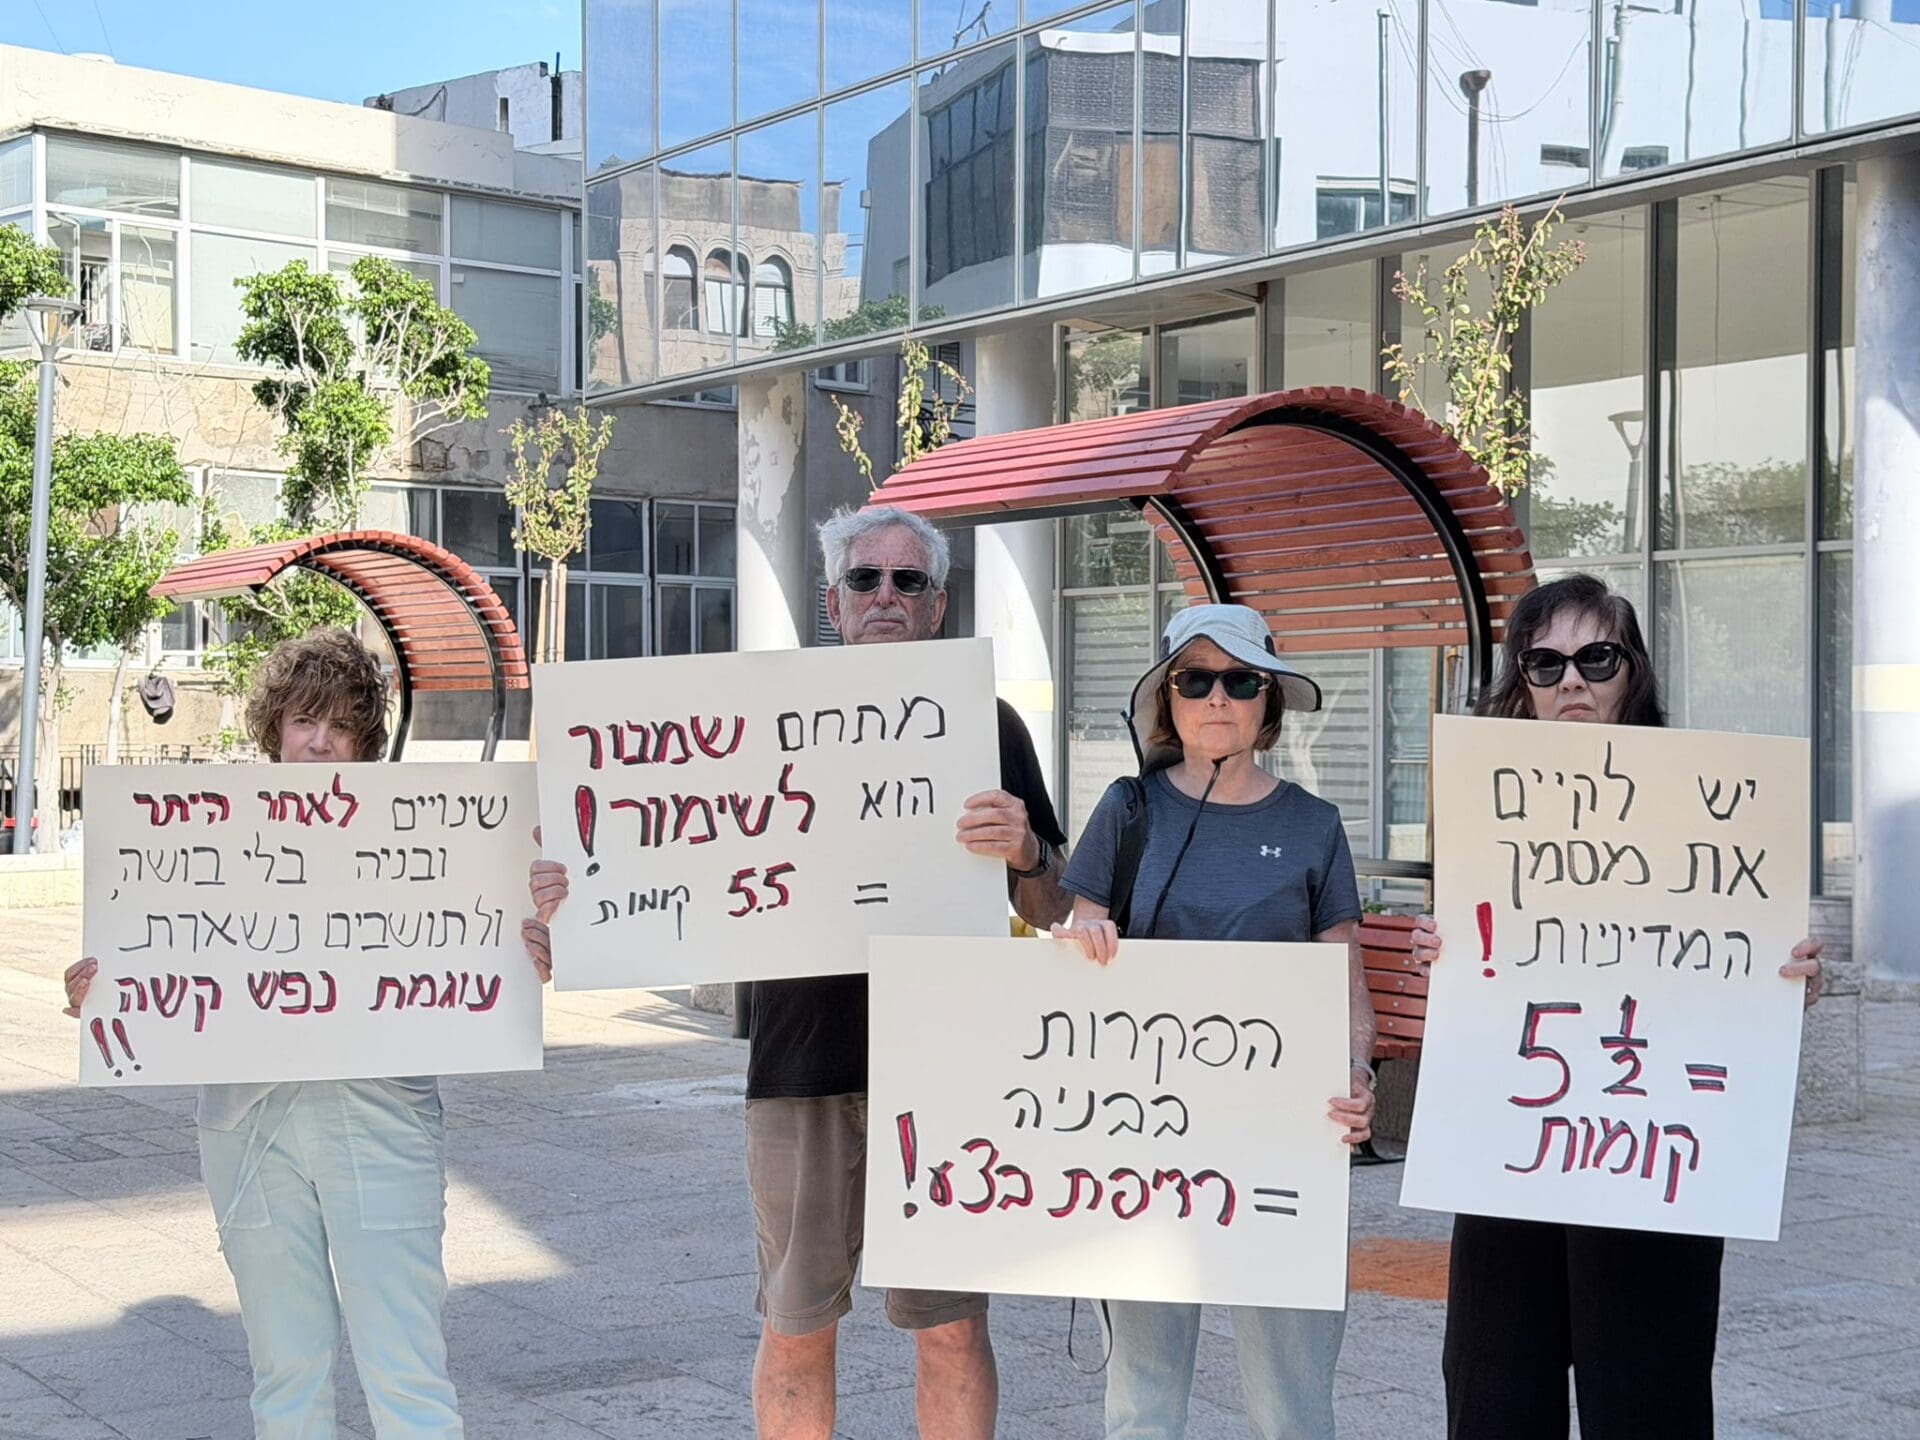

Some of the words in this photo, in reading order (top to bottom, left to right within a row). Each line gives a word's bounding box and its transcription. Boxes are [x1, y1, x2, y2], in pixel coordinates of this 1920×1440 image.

[776, 695, 946, 752] מתחם
[132, 790, 231, 827] היתר
[393, 792, 509, 832] שינויים
[859, 776, 935, 821] הוא
[1493, 740, 1636, 831] לקיים
[1697, 774, 1757, 821] יש
[242, 831, 308, 885] בלי
[355, 847, 447, 882] ובניה
[1496, 840, 1651, 911] מסמך
[1667, 842, 1769, 900] את
[590, 884, 691, 941] קומות
[726, 861, 797, 918] 5.5
[118, 910, 300, 954] נשארת
[324, 894, 504, 952] ולתושבים
[246, 969, 337, 1015] נפש
[367, 970, 502, 1013] עוגמת
[1022, 1010, 1283, 1085] הפקרות
[1002, 1087, 1189, 1139] בבניה
[1504, 1115, 1700, 1204] קומות
